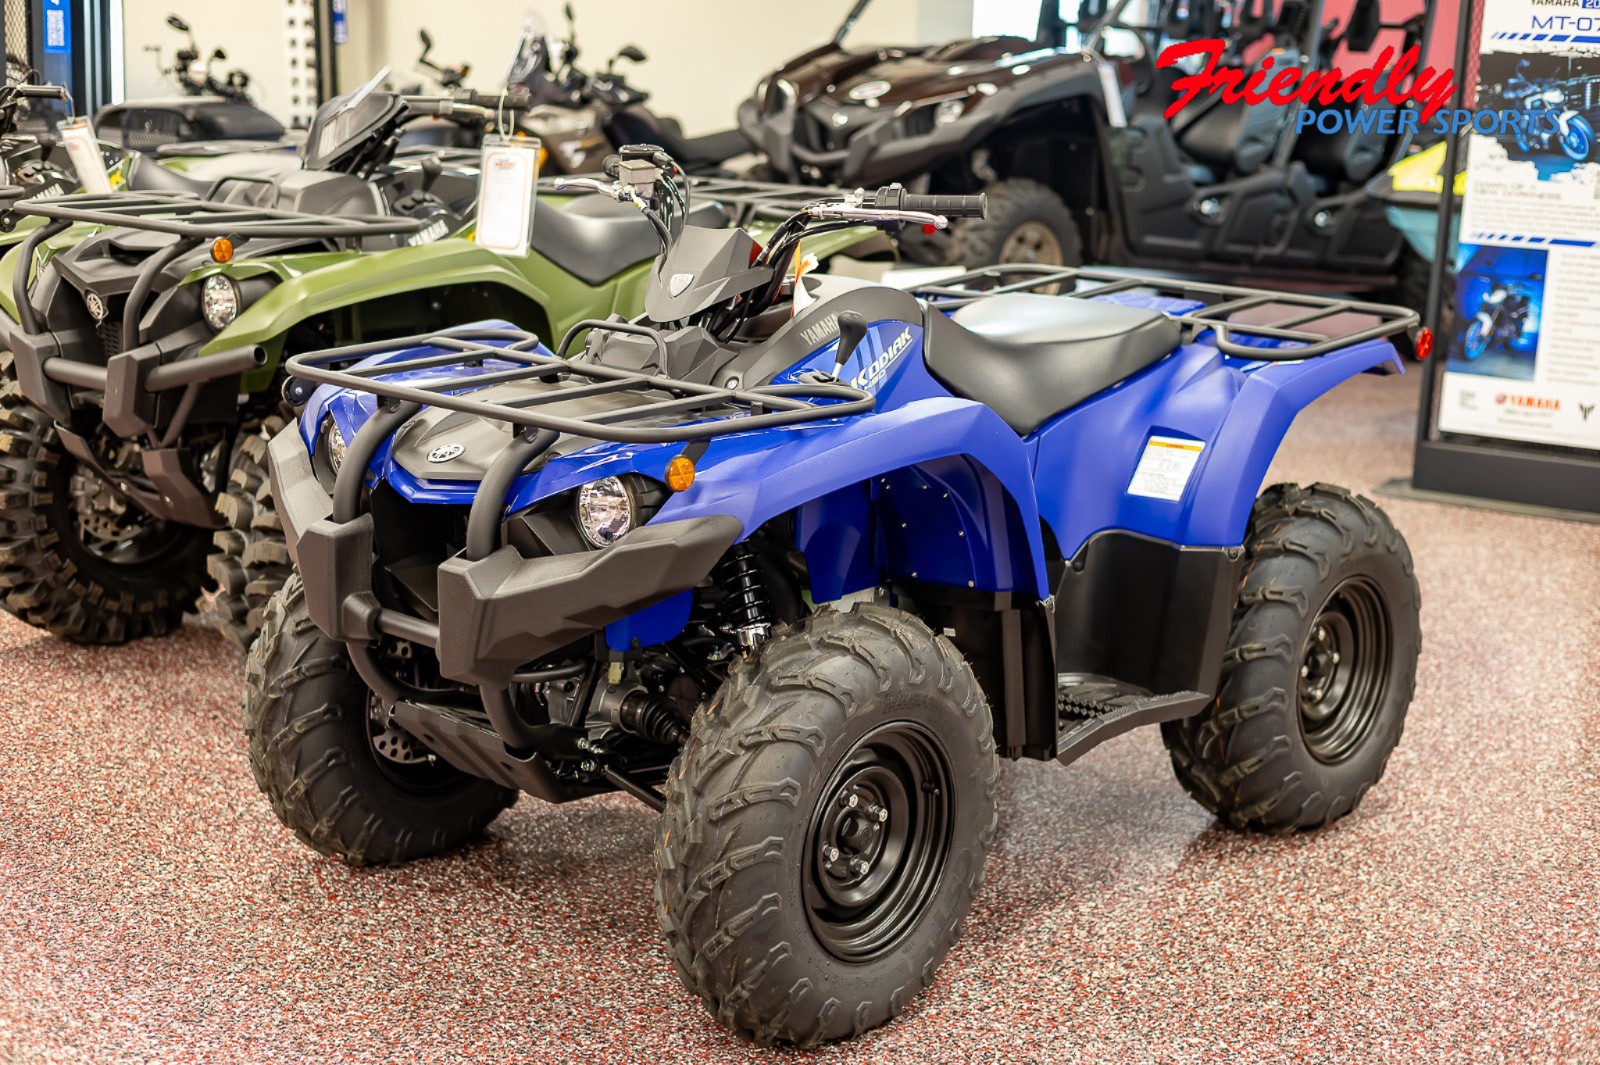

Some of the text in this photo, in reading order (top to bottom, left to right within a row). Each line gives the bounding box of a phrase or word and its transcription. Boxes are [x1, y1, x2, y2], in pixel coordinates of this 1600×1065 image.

[31, 183, 65, 201] MAHA
[408, 219, 449, 247] YAMAHA
[851, 327, 912, 389] KODIAK
